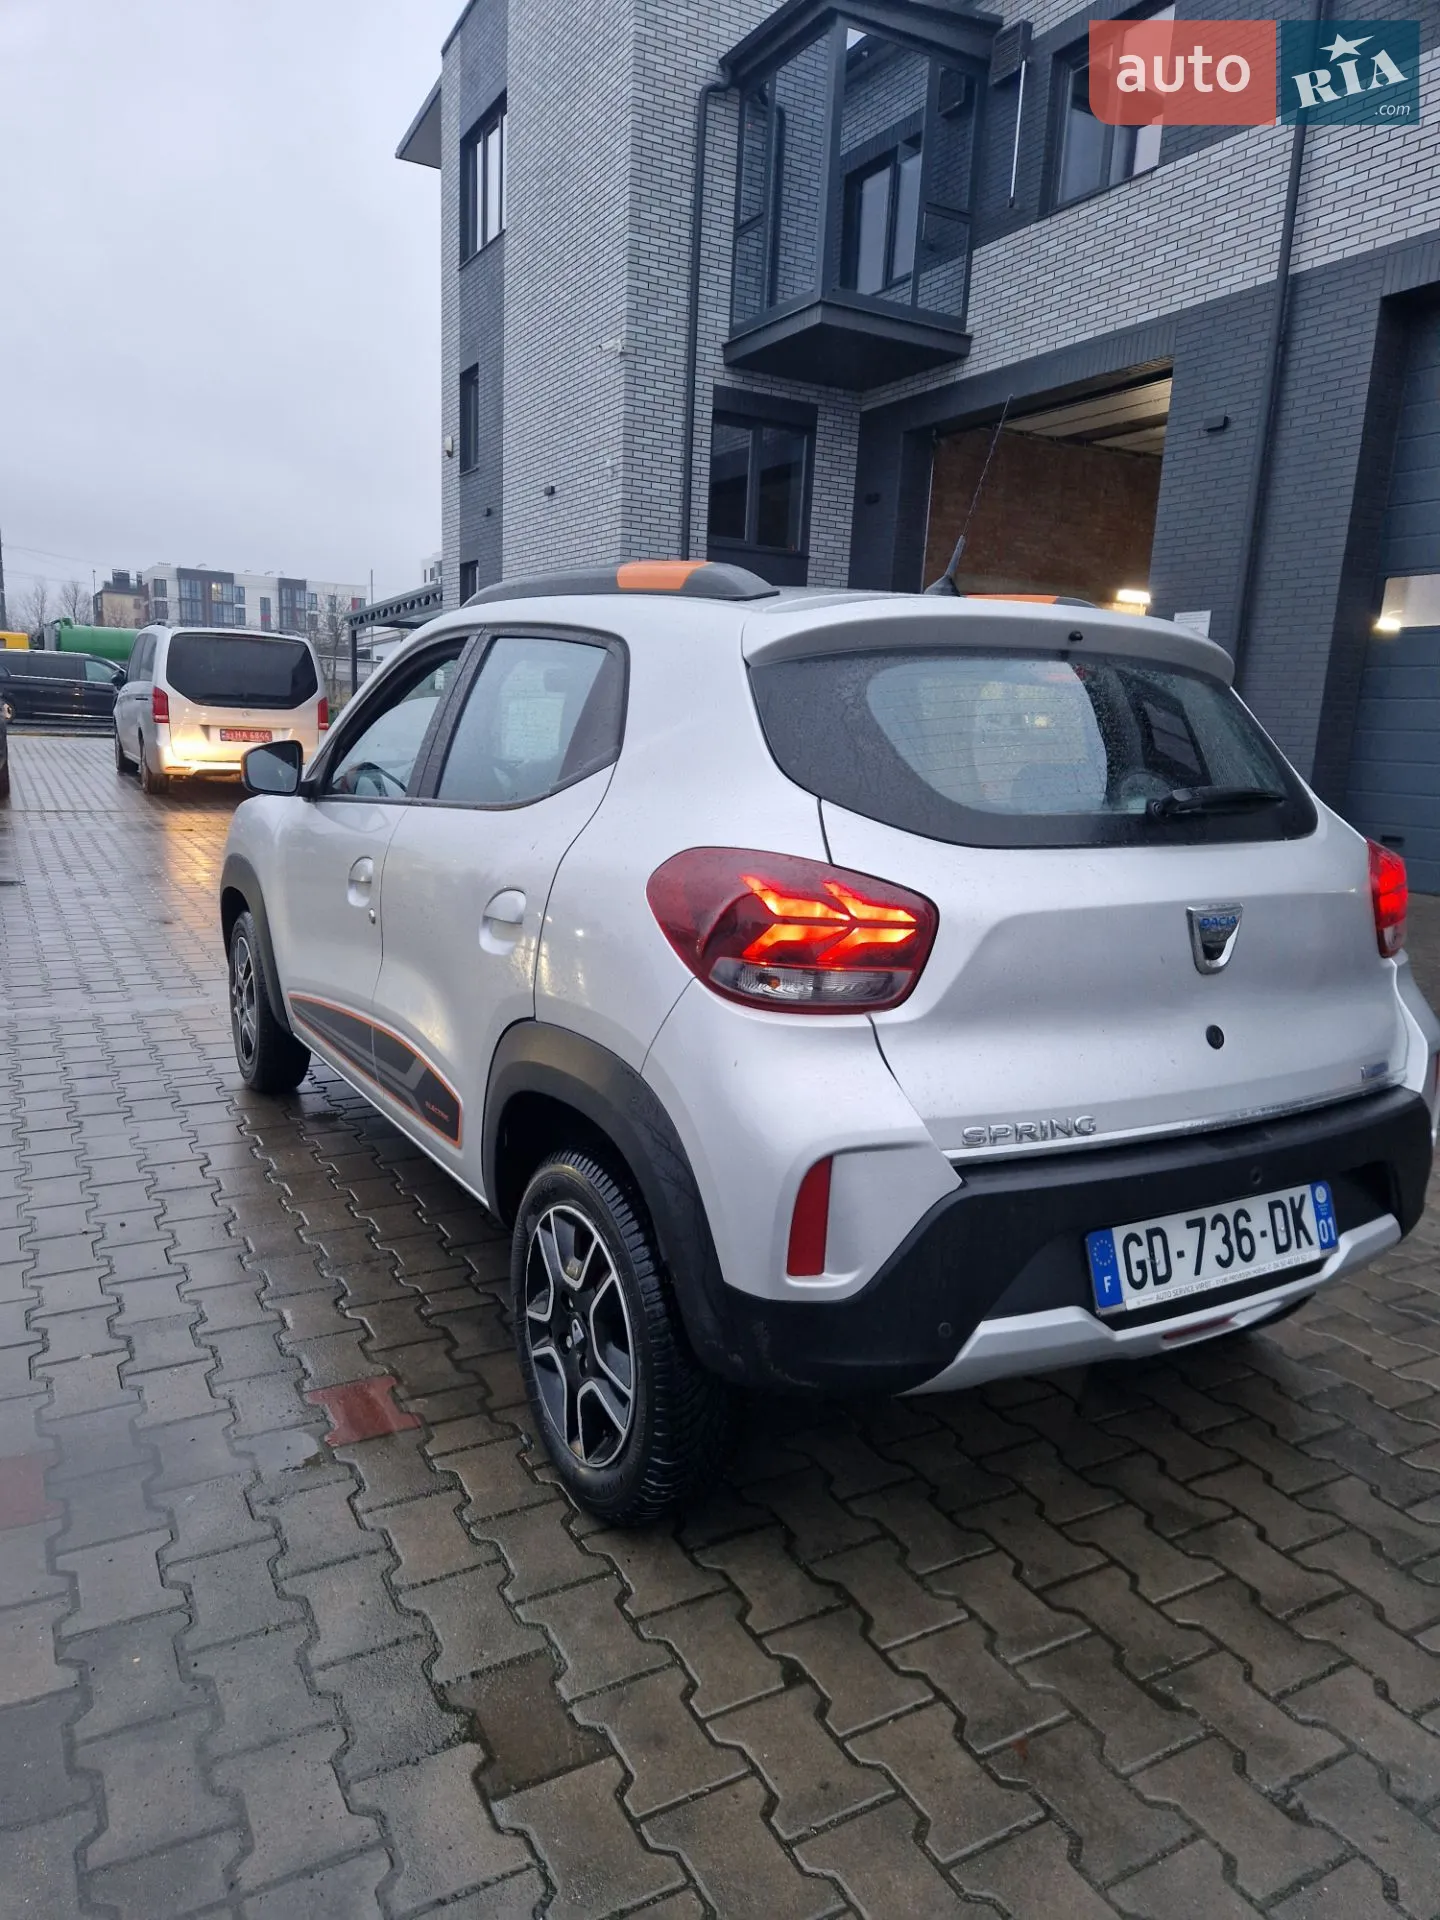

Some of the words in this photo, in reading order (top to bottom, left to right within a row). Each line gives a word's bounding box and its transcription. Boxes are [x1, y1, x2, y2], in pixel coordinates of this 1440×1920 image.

[1200, 915, 1237, 928] DACIA
[962, 1115, 1097, 1146] SPRING
[1122, 1193, 1314, 1291] GD-736-DK
[1318, 1216, 1336, 1244] 01
[1103, 1276, 1113, 1293] F
